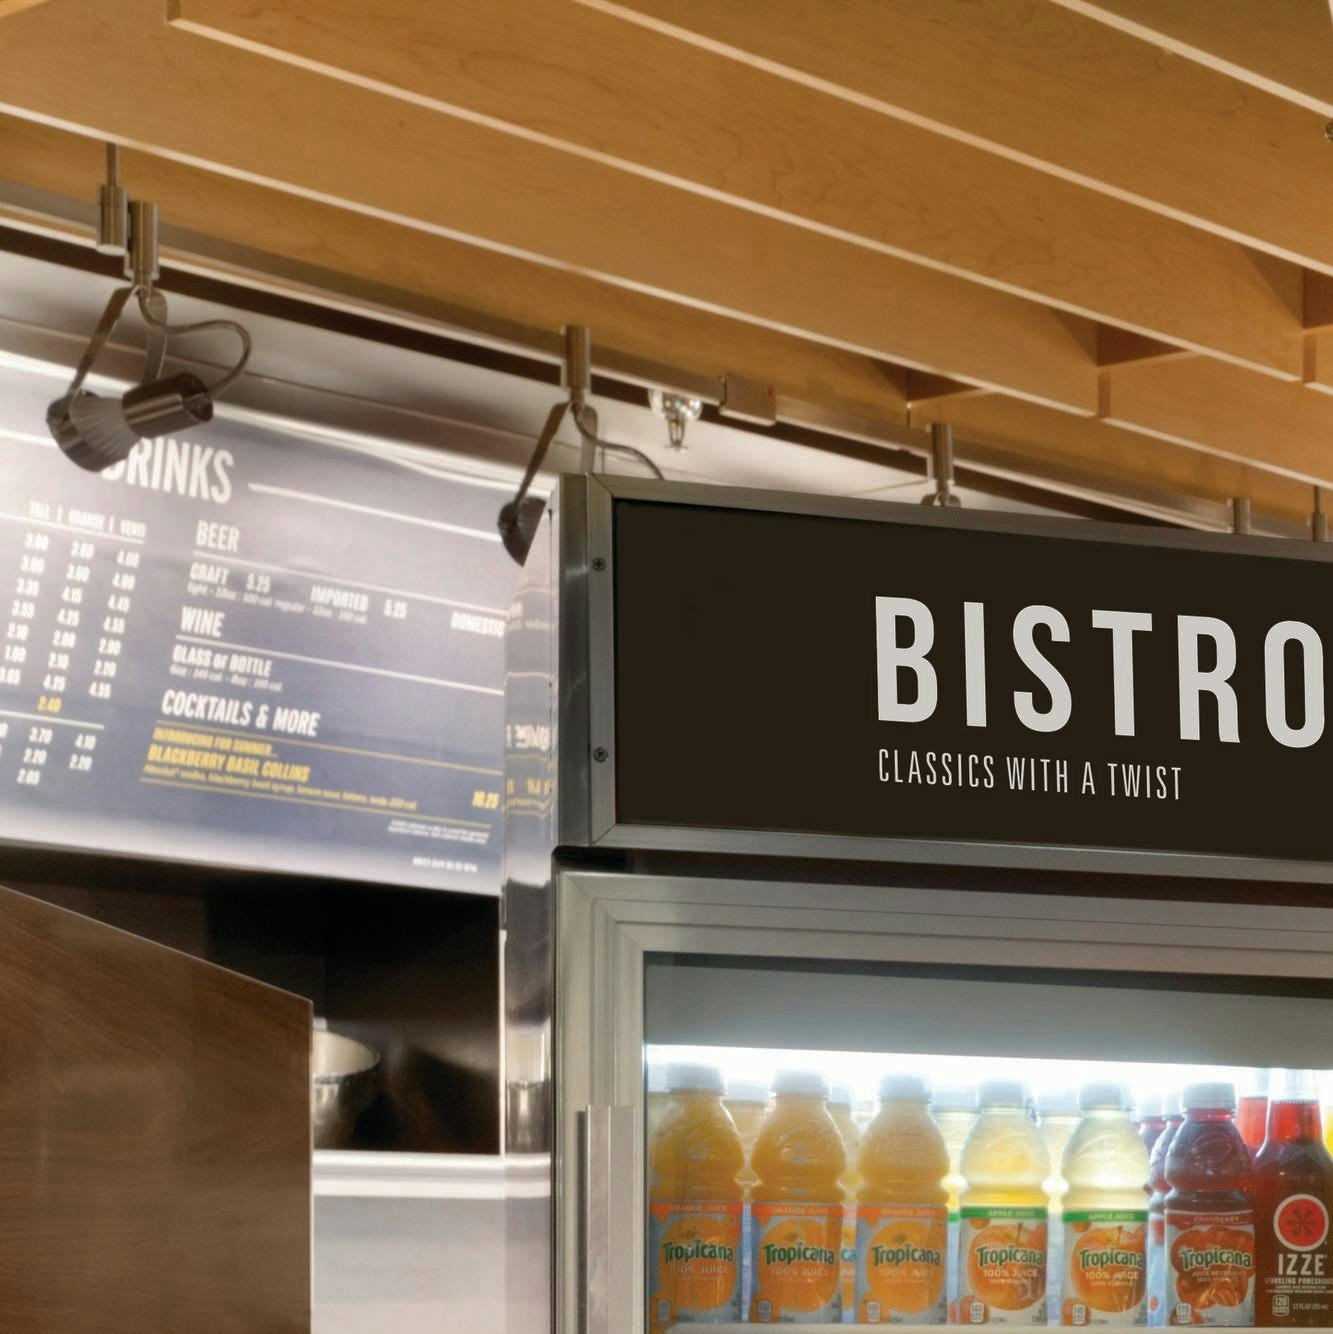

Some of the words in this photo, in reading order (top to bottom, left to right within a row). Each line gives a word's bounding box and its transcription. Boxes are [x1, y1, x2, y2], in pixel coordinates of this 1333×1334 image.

[195, 519, 240, 552] BEER
[190, 562, 230, 585] CRAFT
[246, 573, 271, 593] 5.25
[310, 584, 369, 613] IMPORTED
[384, 599, 408, 619] 5.25
[180, 606, 226, 638] WINE
[172, 644, 212, 668] GLASS
[213, 653, 228, 669] or
[229, 655, 273, 678] BOTTLE
[875, 595, 1325, 750] BISTRO
[162, 688, 254, 727] COCKTAILS
[255, 704, 270, 729] &
[272, 707, 322, 737] MORE
[148, 744, 226, 771] BLACKBERRY
[226, 755, 261, 776] BASIL
[262, 760, 311, 784] COLLINS
[878, 748, 995, 789] CLASSICS
[1006, 756, 1070, 793] WITH
[1081, 761, 1097, 795] A
[1107, 762, 1183, 800] TWIST
[662, 1240, 734, 1264] Tropicana
[763, 1243, 835, 1265] Tropicana
[871, 1244, 940, 1266] Tropicana
[976, 1245, 1044, 1268] Tropicana
[1078, 1247, 1144, 1269] Tropicana
[1180, 1248, 1251, 1270] Tropicana
[1278, 1253, 1325, 1276] IZZE
[983, 1269, 1009, 1278] 100%
[1012, 1269, 1038, 1278] JUICE
[1085, 1271, 1110, 1280] 100%
